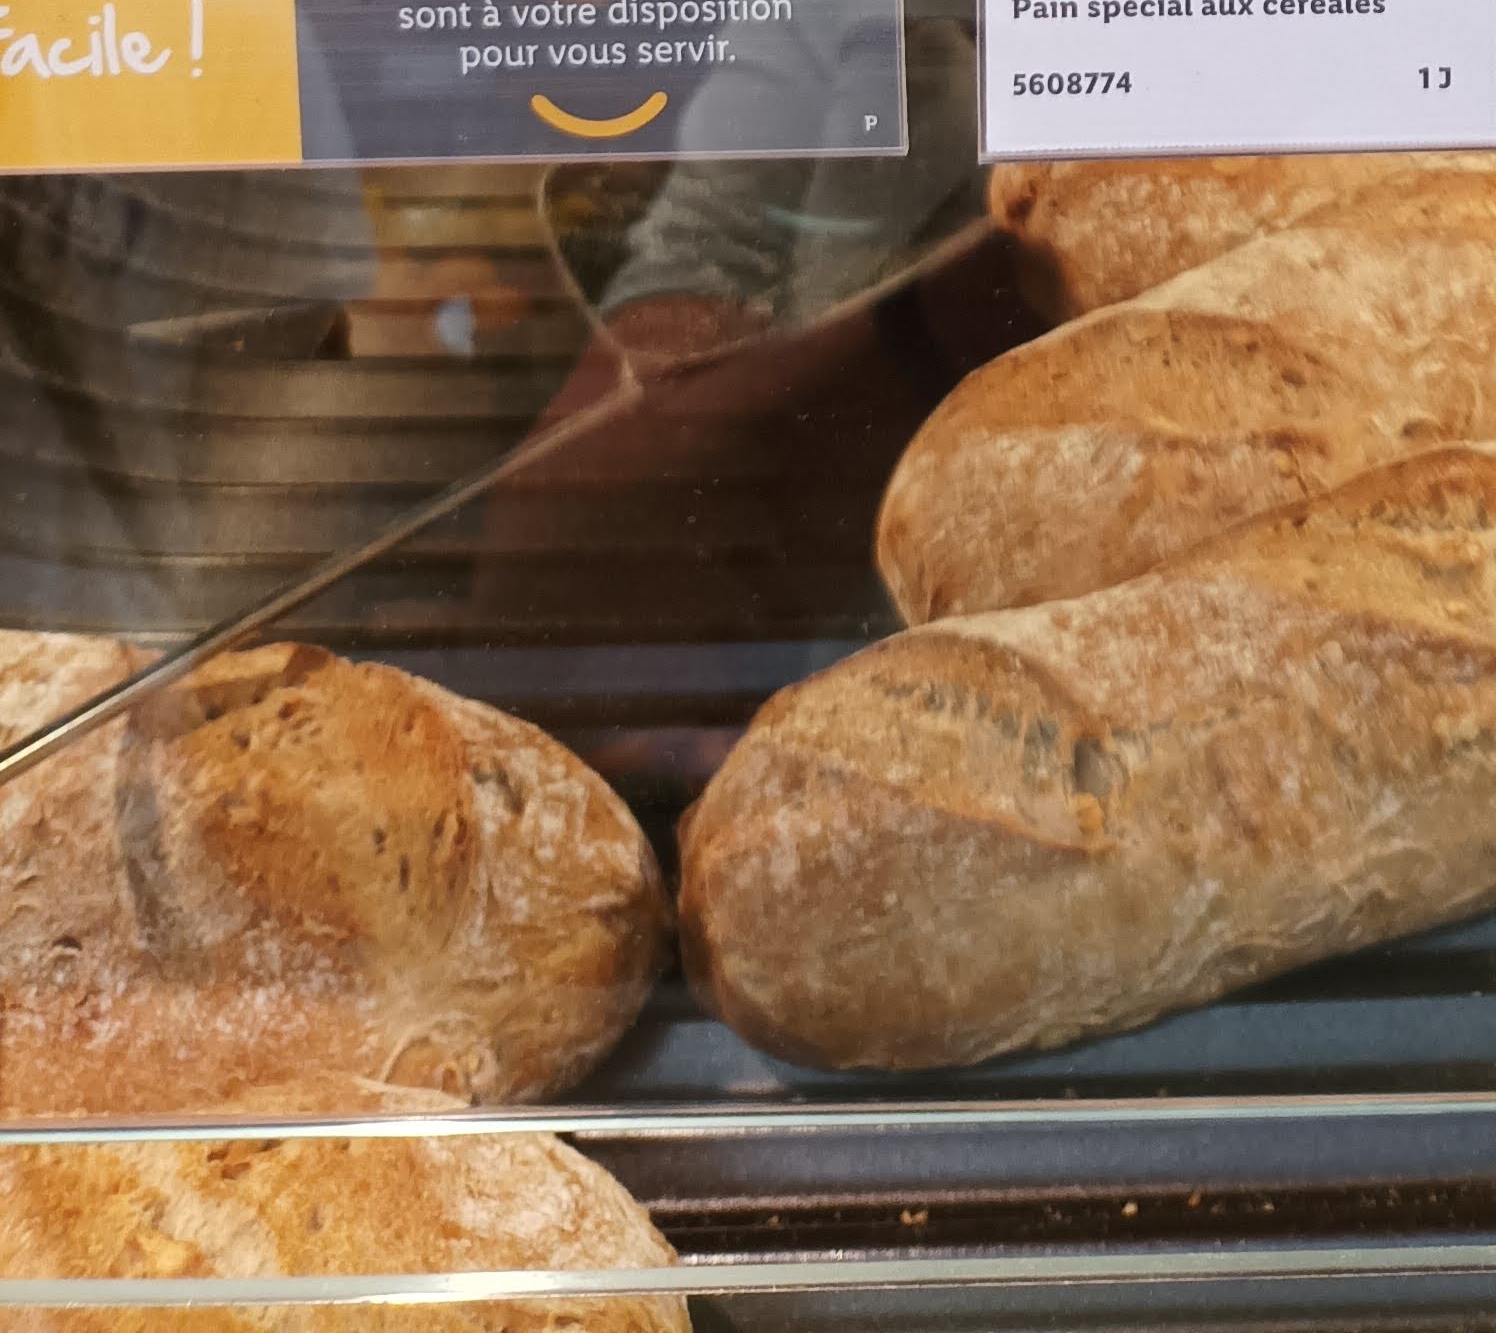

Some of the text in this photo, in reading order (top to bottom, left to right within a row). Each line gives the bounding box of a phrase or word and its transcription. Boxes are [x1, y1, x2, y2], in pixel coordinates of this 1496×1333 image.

[398, 2, 472, 30] sont
[511, 0, 597, 27] votre
[0, 2, 173, 79] acile
[459, 32, 736, 76] pour vous servir.
[1012, 71, 1132, 96] 5608774
[863, 114, 879, 132] P
